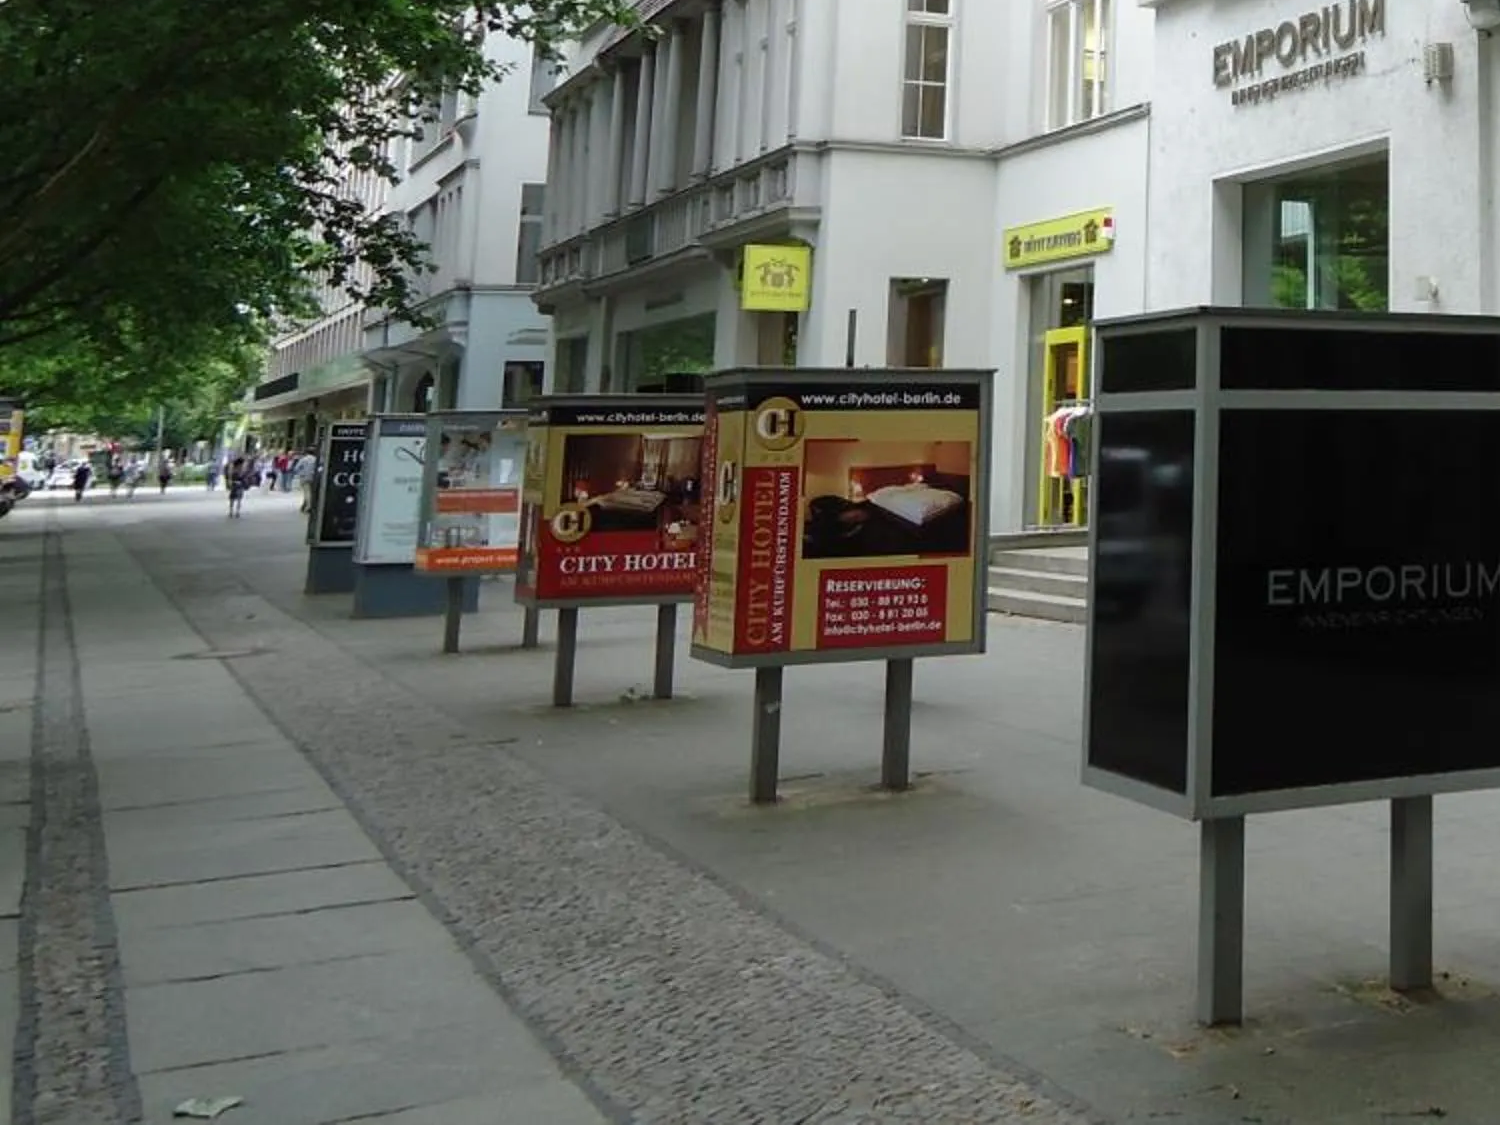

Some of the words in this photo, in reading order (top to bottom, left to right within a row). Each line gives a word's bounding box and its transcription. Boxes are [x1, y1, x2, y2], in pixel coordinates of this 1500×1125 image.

[801, 392, 961, 406] www.cityhotel-berlin.de
[752, 471, 775, 568] HOTEL
[559, 555, 618, 573] CITY
[748, 579, 768, 645] CITY
[771, 623, 783, 644] AM
